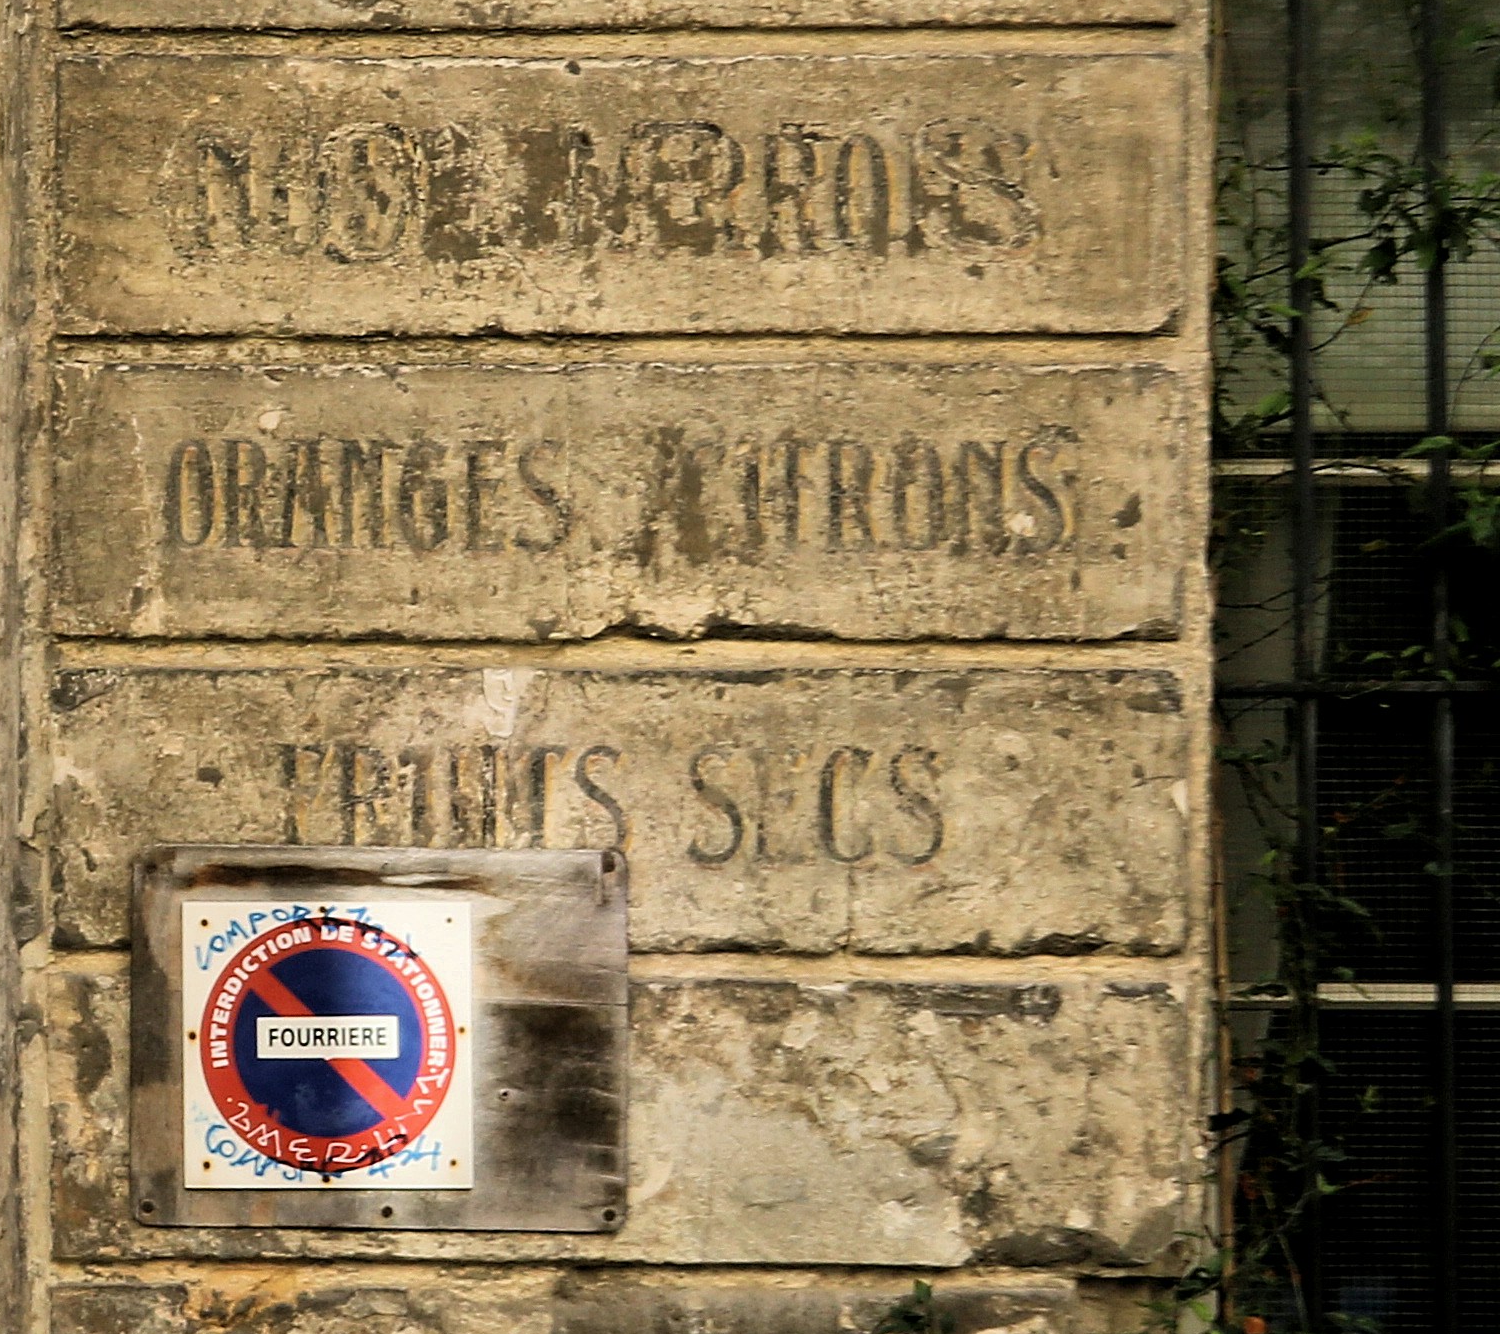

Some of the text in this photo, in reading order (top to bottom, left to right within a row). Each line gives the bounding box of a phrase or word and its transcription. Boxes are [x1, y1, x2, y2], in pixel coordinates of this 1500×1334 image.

[166, 437, 572, 553] ORANGES
[209, 925, 313, 1069] INTERDICTION
[320, 923, 356, 944] DE
[360, 930, 451, 1068] STATIONNER
[268, 1026, 388, 1048] FOURRIERE
